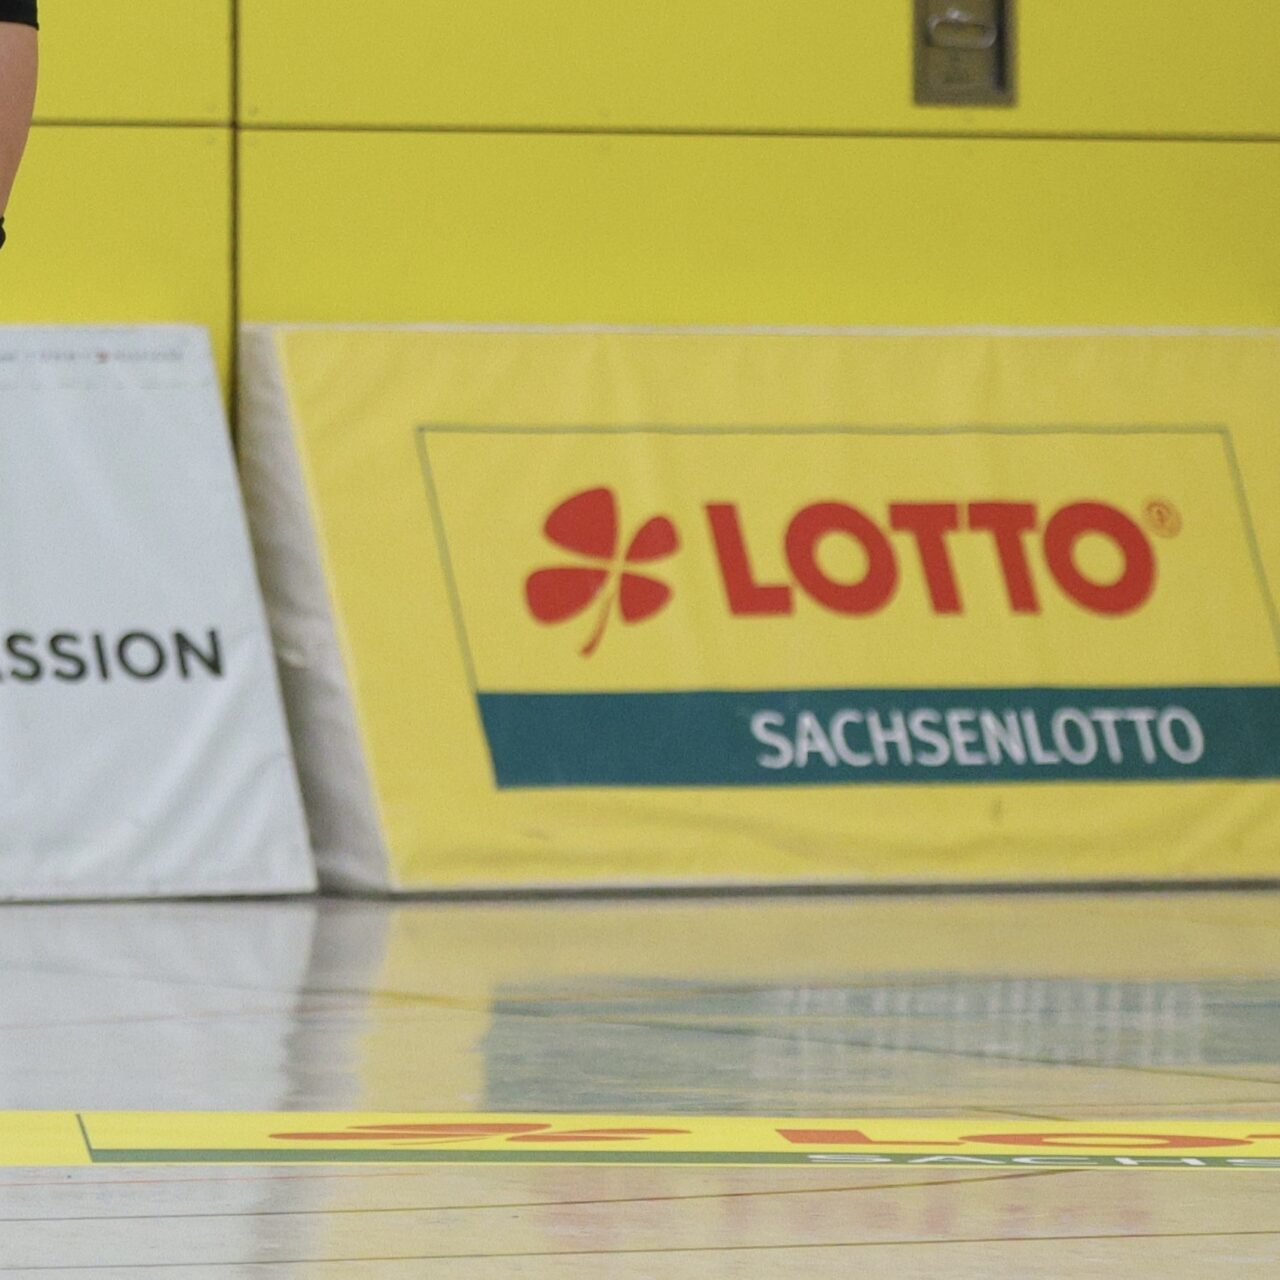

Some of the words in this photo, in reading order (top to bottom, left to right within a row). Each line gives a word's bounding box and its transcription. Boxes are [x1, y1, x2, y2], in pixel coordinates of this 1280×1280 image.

[704, 499, 1158, 618] LOTTO
[749, 706, 1207, 770] SACHSENLOTTO
[774, 1128, 1280, 1150] LO
